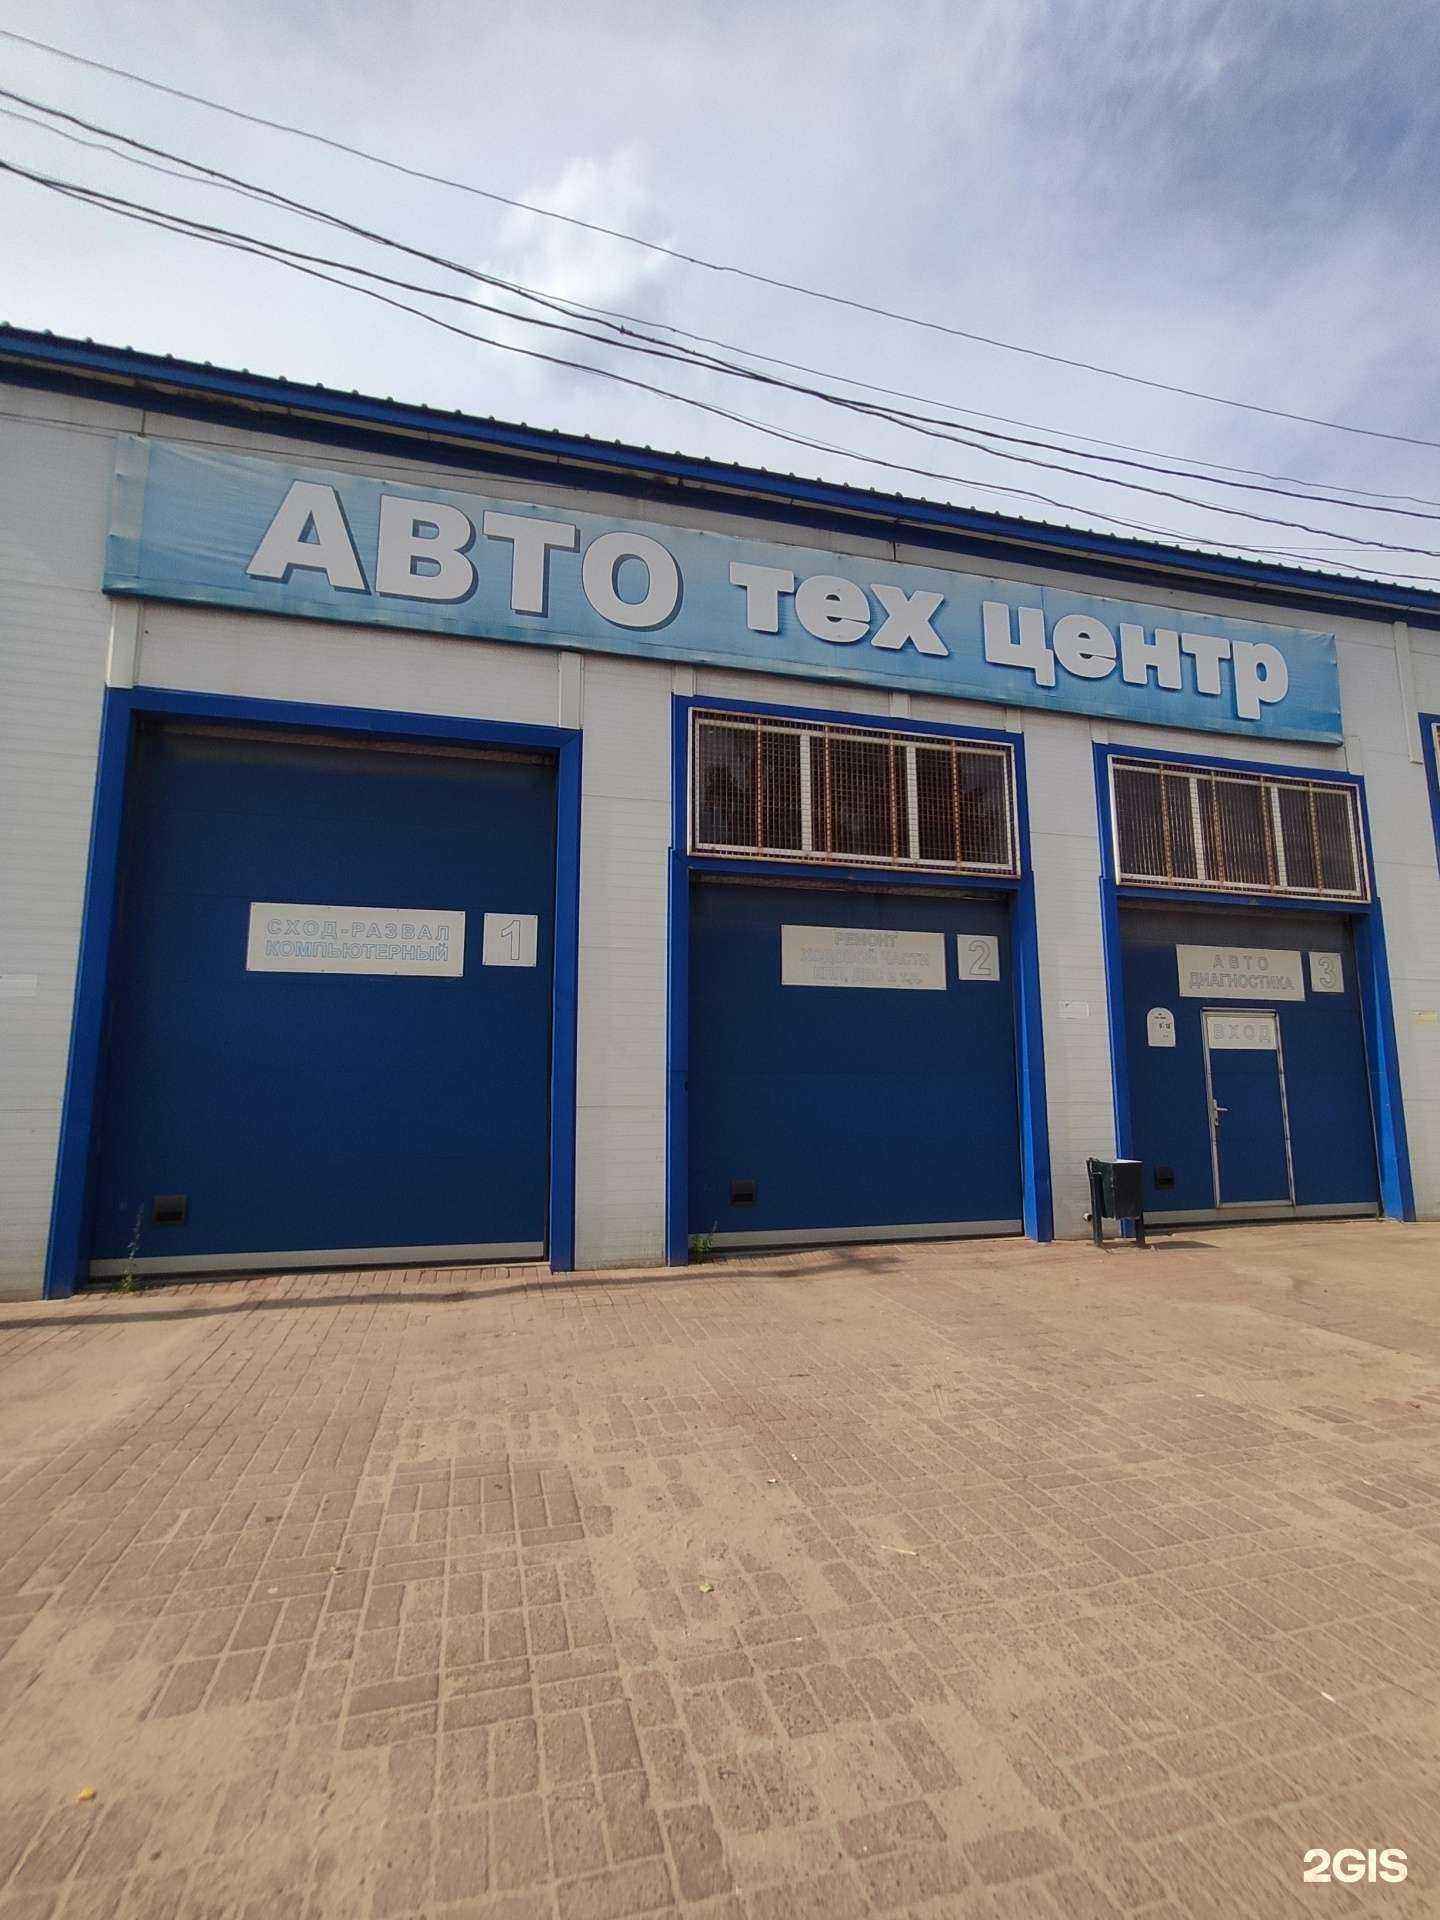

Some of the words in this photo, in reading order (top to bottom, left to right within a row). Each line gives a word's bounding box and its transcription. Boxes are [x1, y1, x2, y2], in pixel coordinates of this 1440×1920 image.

[247, 478, 684, 632] АВТО
[729, 560, 949, 657] тех
[981, 600, 1290, 720] центр
[266, 918, 449, 941] СХОД-РАЗВАЛ
[500, 919, 521, 961] 1
[264, 940, 449, 962] КОМПЬЮТЕРНЫЙ
[968, 939, 992, 977] 2
[1212, 954, 1270, 971] АВТО
[1189, 971, 1295, 990] ДИАГНОСТИКА
[1318, 956, 1337, 989] 3
[1213, 1023, 1271, 1043] ВХОД
